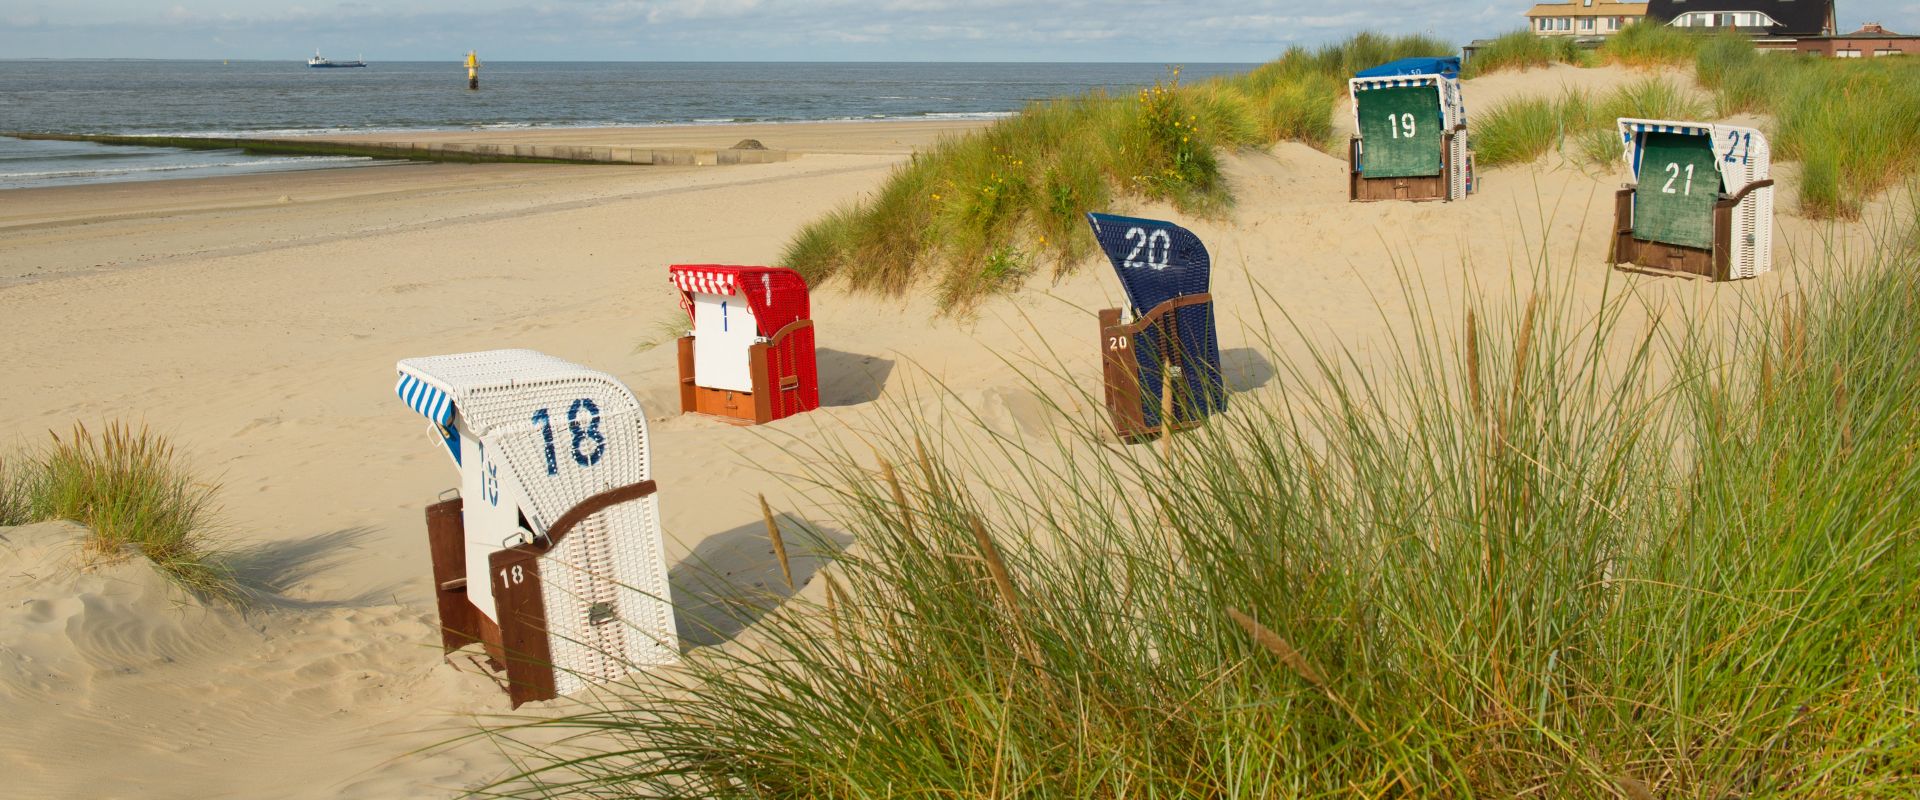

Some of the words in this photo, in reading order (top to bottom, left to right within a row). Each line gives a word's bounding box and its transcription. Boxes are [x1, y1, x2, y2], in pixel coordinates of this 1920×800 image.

[1388, 113, 1416, 139] 19
[1724, 130, 1751, 165] 21
[1662, 162, 1695, 196] 21
[1123, 227, 1170, 270] 20
[761, 273, 772, 306] 1
[721, 301, 728, 332] 1
[1109, 336, 1127, 350] 20
[532, 398, 606, 477] 18
[500, 565, 524, 589] 18
